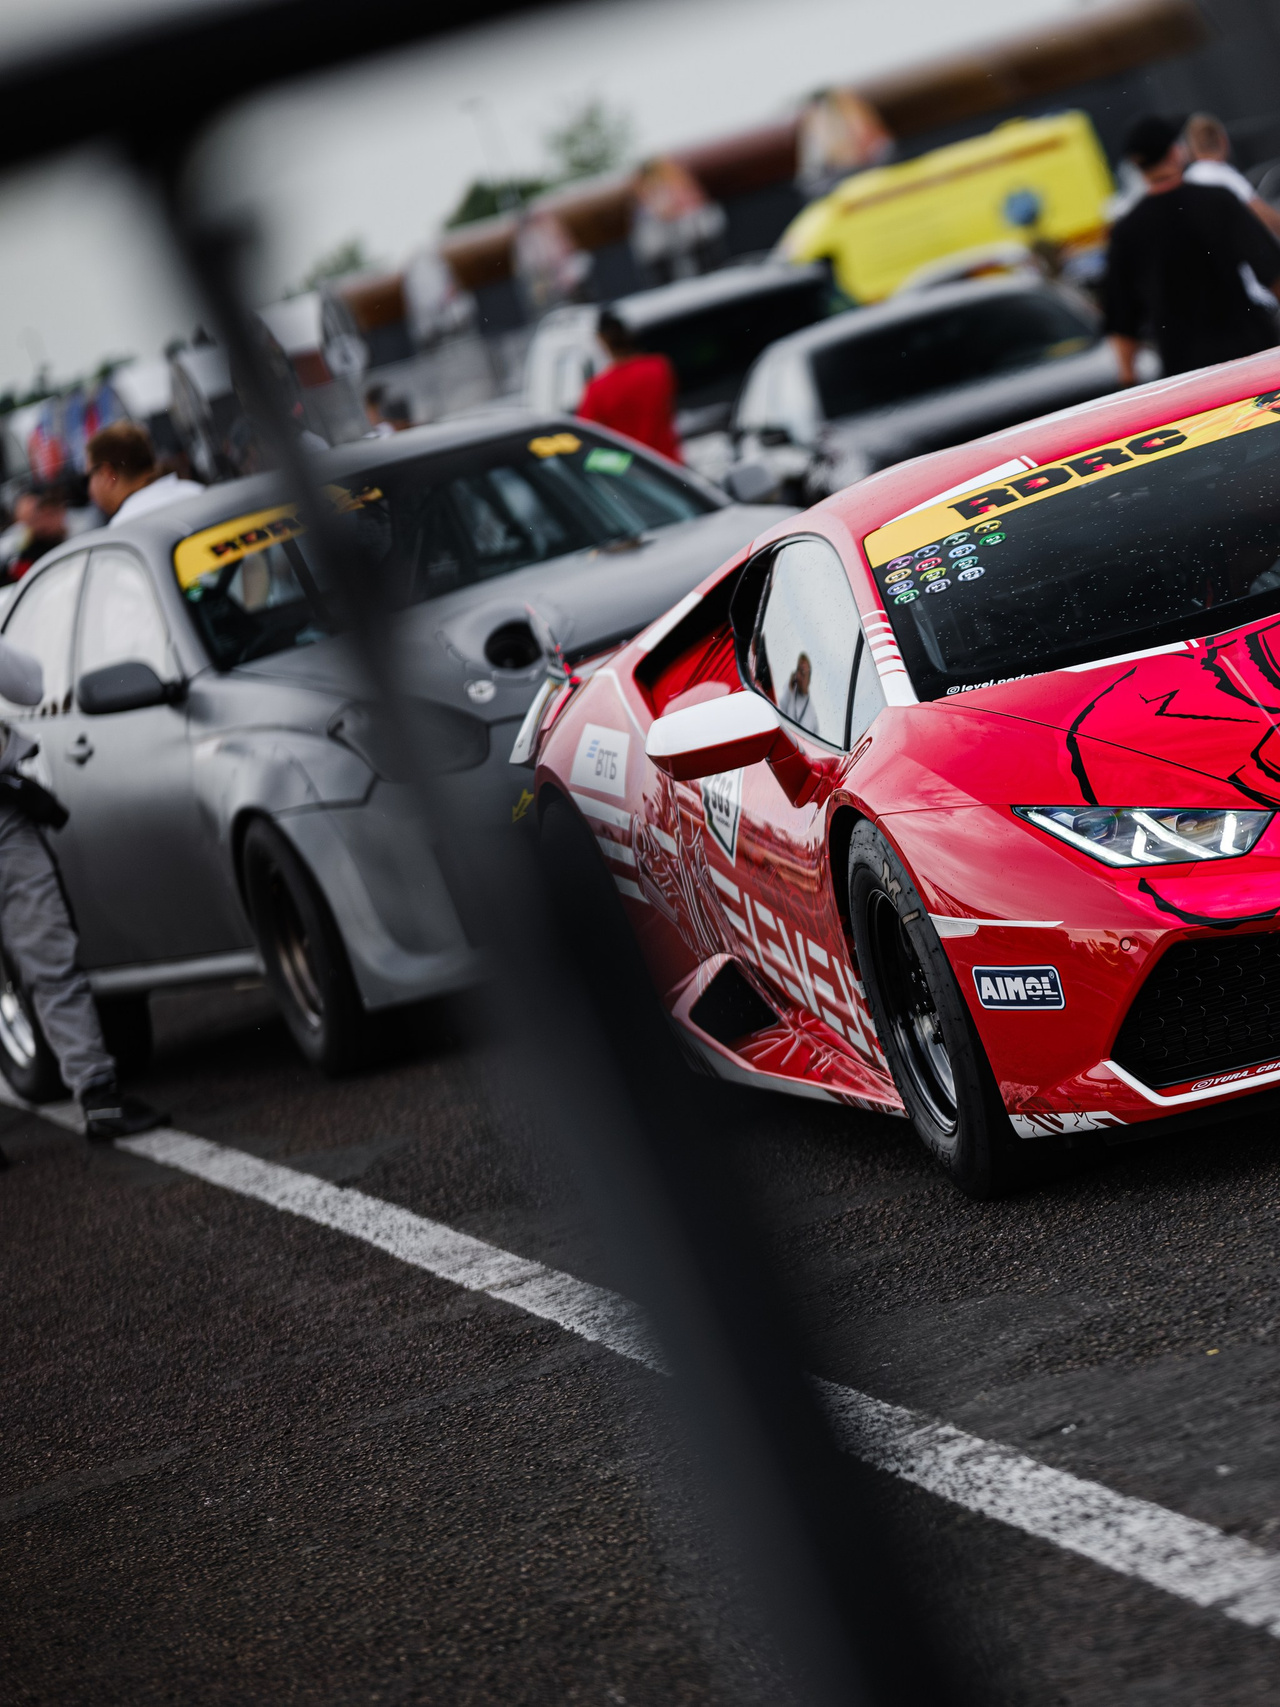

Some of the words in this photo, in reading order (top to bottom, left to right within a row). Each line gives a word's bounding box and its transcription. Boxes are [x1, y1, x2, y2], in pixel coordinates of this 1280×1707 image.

[947, 429, 1188, 511] RDRC
[209, 516, 302, 557] RDR
[595, 748, 618, 780] ВТБ
[981, 976, 1060, 1001] AIMOL
